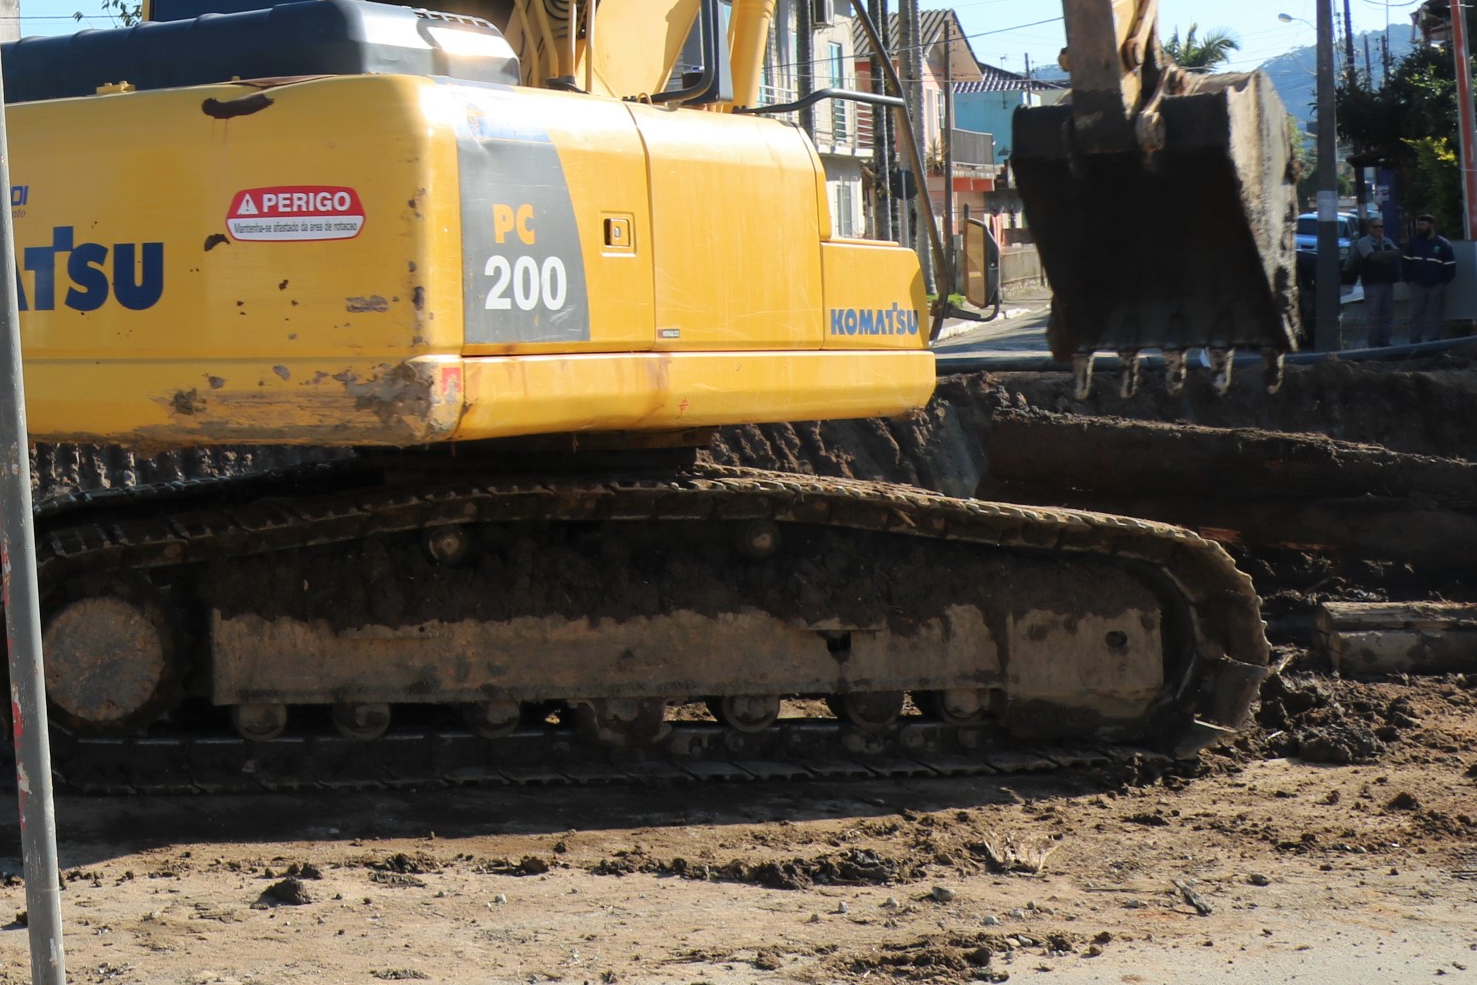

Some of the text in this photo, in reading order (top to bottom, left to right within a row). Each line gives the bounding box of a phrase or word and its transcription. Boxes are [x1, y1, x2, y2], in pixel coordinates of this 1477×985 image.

[263, 191, 351, 212] PERIGO
[273, 221, 299, 232] afastado
[301, 222, 308, 232] da
[324, 221, 332, 231] de
[492, 204, 535, 245] PC
[484, 254, 567, 312] 200
[830, 302, 919, 335] KOMATSU
